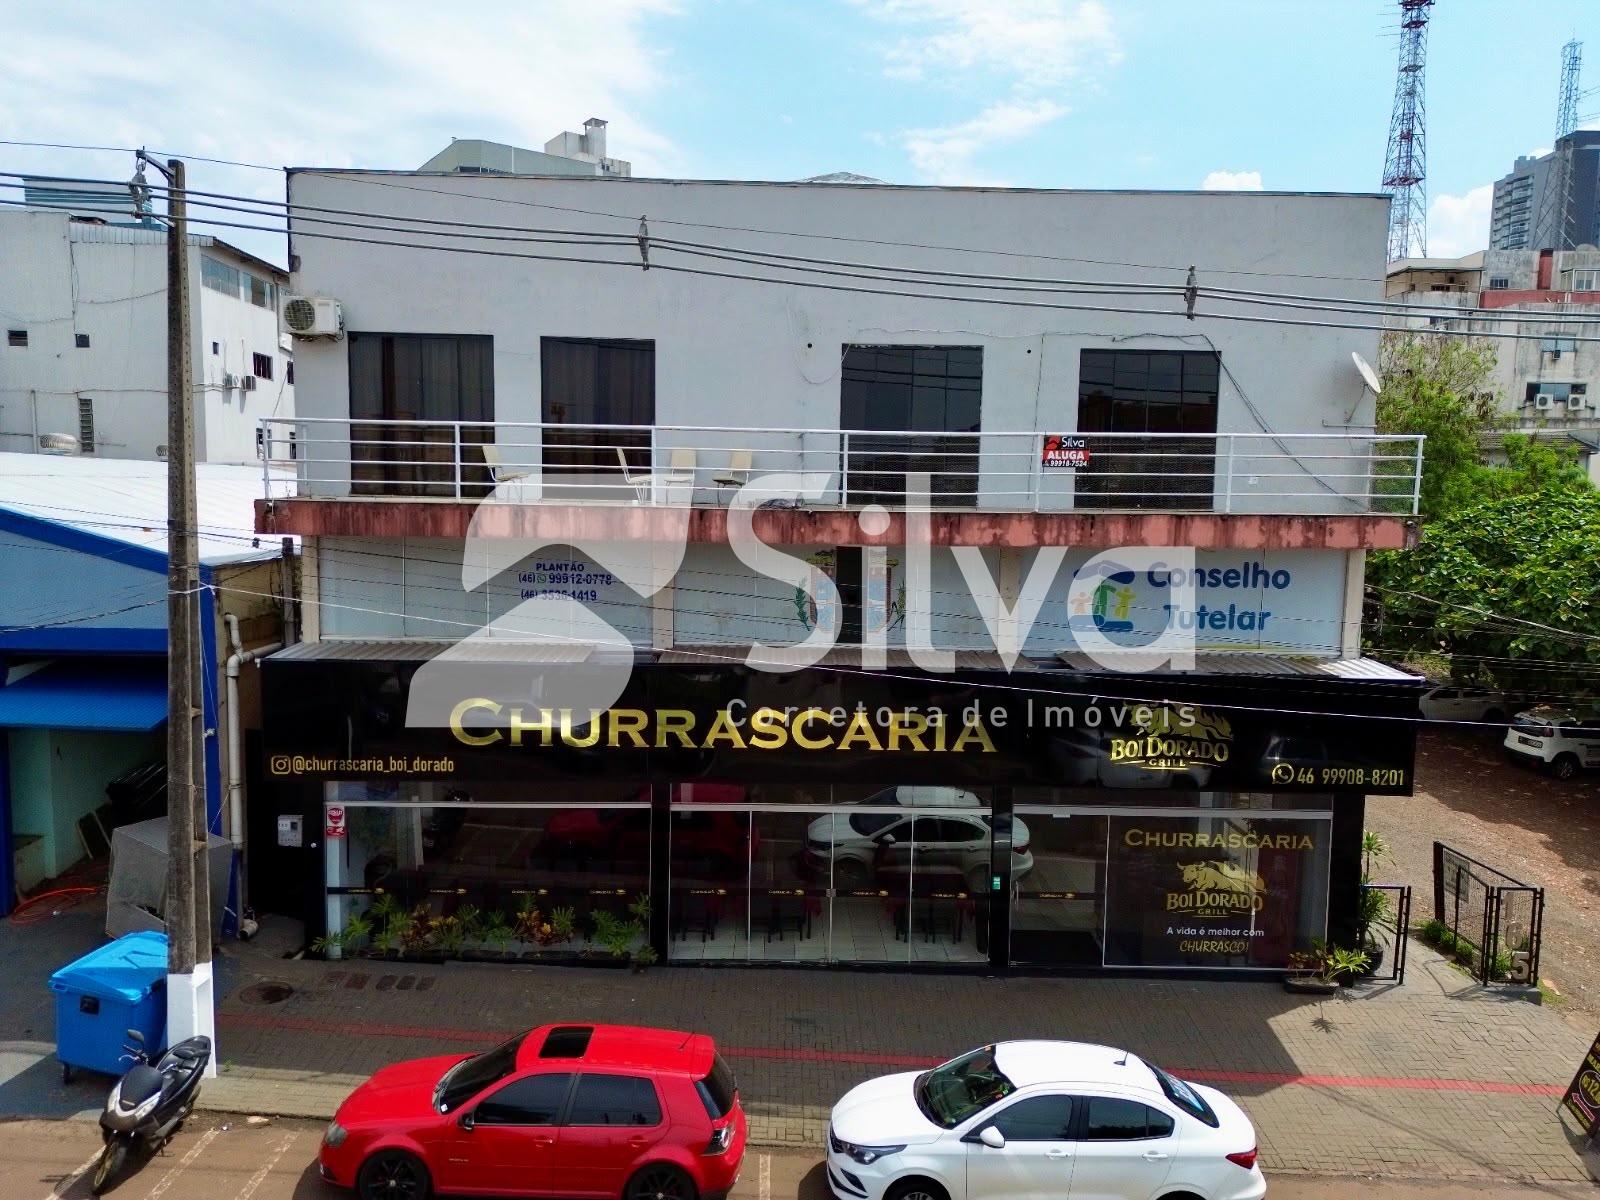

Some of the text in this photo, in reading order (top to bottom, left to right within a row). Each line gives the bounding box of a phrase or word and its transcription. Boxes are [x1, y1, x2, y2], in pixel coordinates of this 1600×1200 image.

[1061, 436, 1085, 448] Silva
[1047, 450, 1085, 460] ALUGA
[535, 562, 585, 572] PLANTÃO
[1147, 561, 1291, 589] Conselho
[518, 572, 613, 585] (46) 99912-0778
[1163, 603, 1271, 630] Tutelar
[450, 697, 999, 752] CHURRASCARIA
[1110, 736, 1229, 762] BOI DORADO
[292, 755, 455, 774] @churrascaria_boi_dorado
[1148, 758, 1186, 767] GRILL
[1297, 767, 1404, 786] 46 99908-8201
[1124, 828, 1315, 849] CHURRASCARIA
[1166, 890, 1264, 912] BOI DORADO
[1197, 908, 1228, 916] GRILL
[1166, 925, 1265, 937] A vida é melhor com
